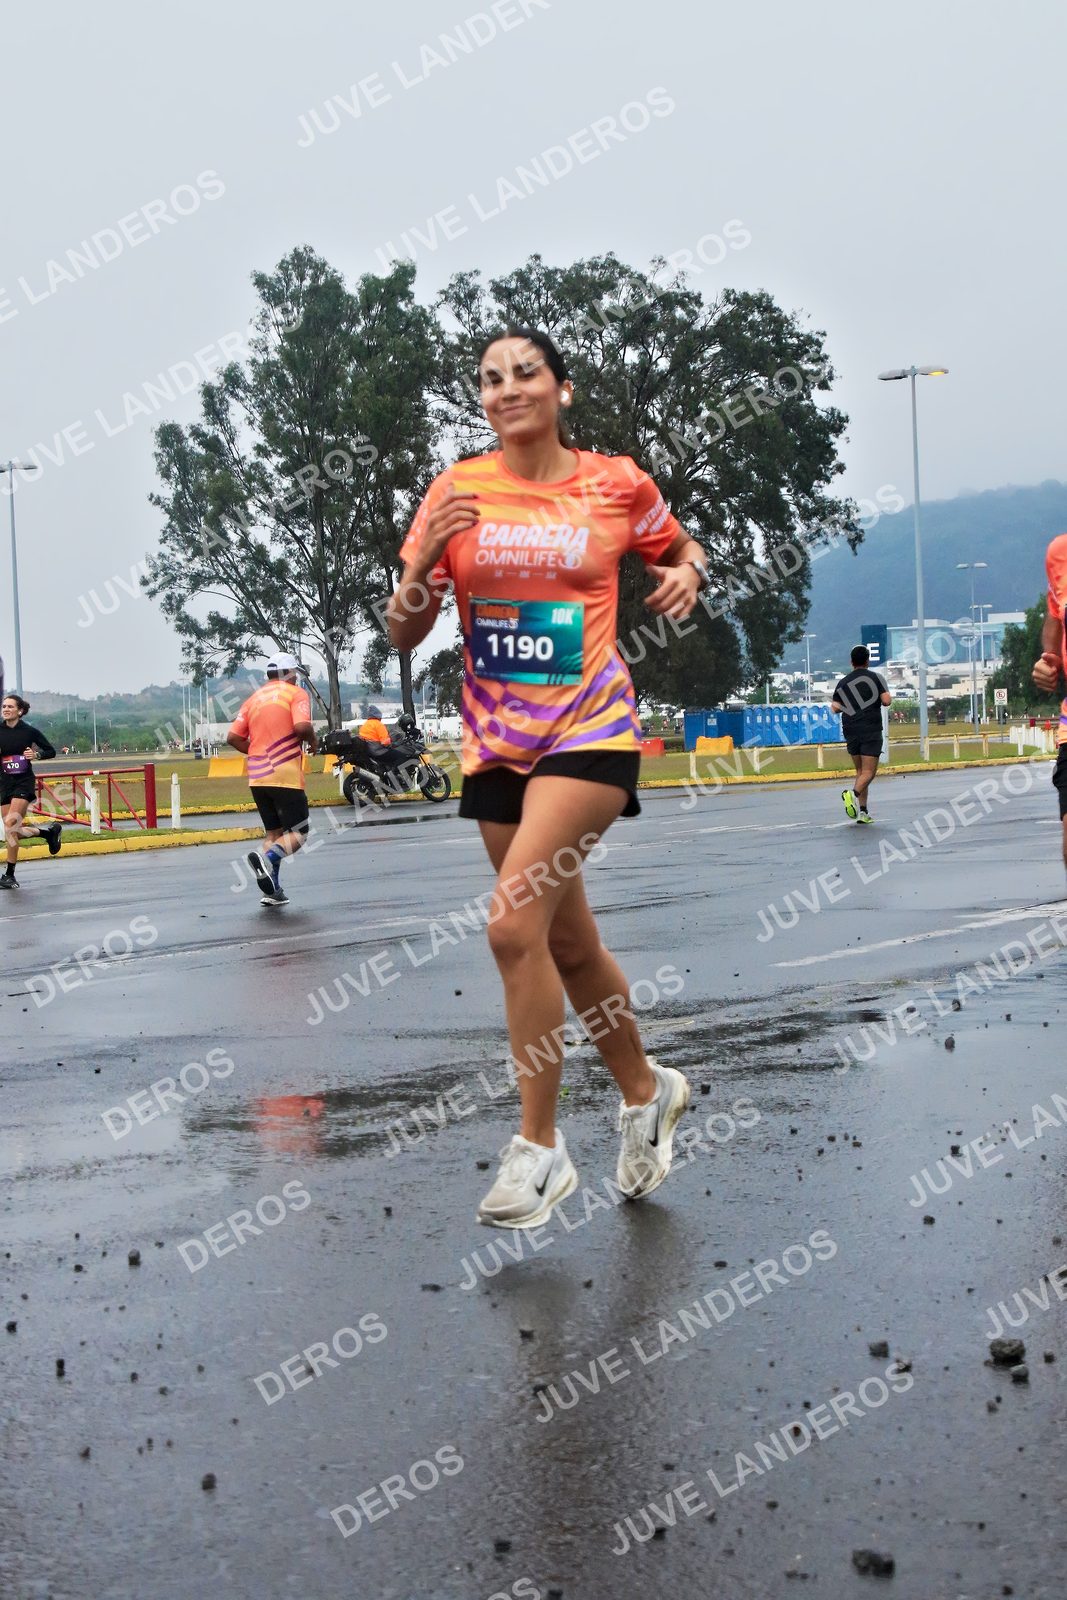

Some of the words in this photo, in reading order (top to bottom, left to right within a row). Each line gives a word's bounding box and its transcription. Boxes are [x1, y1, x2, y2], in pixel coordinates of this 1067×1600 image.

[478, 522, 590, 554] CARRERA
[475, 549, 558, 568] OMNILIFE
[552, 608, 574, 625] 10K
[487, 633, 554, 661] 1190
[866, 642, 880, 661] E
